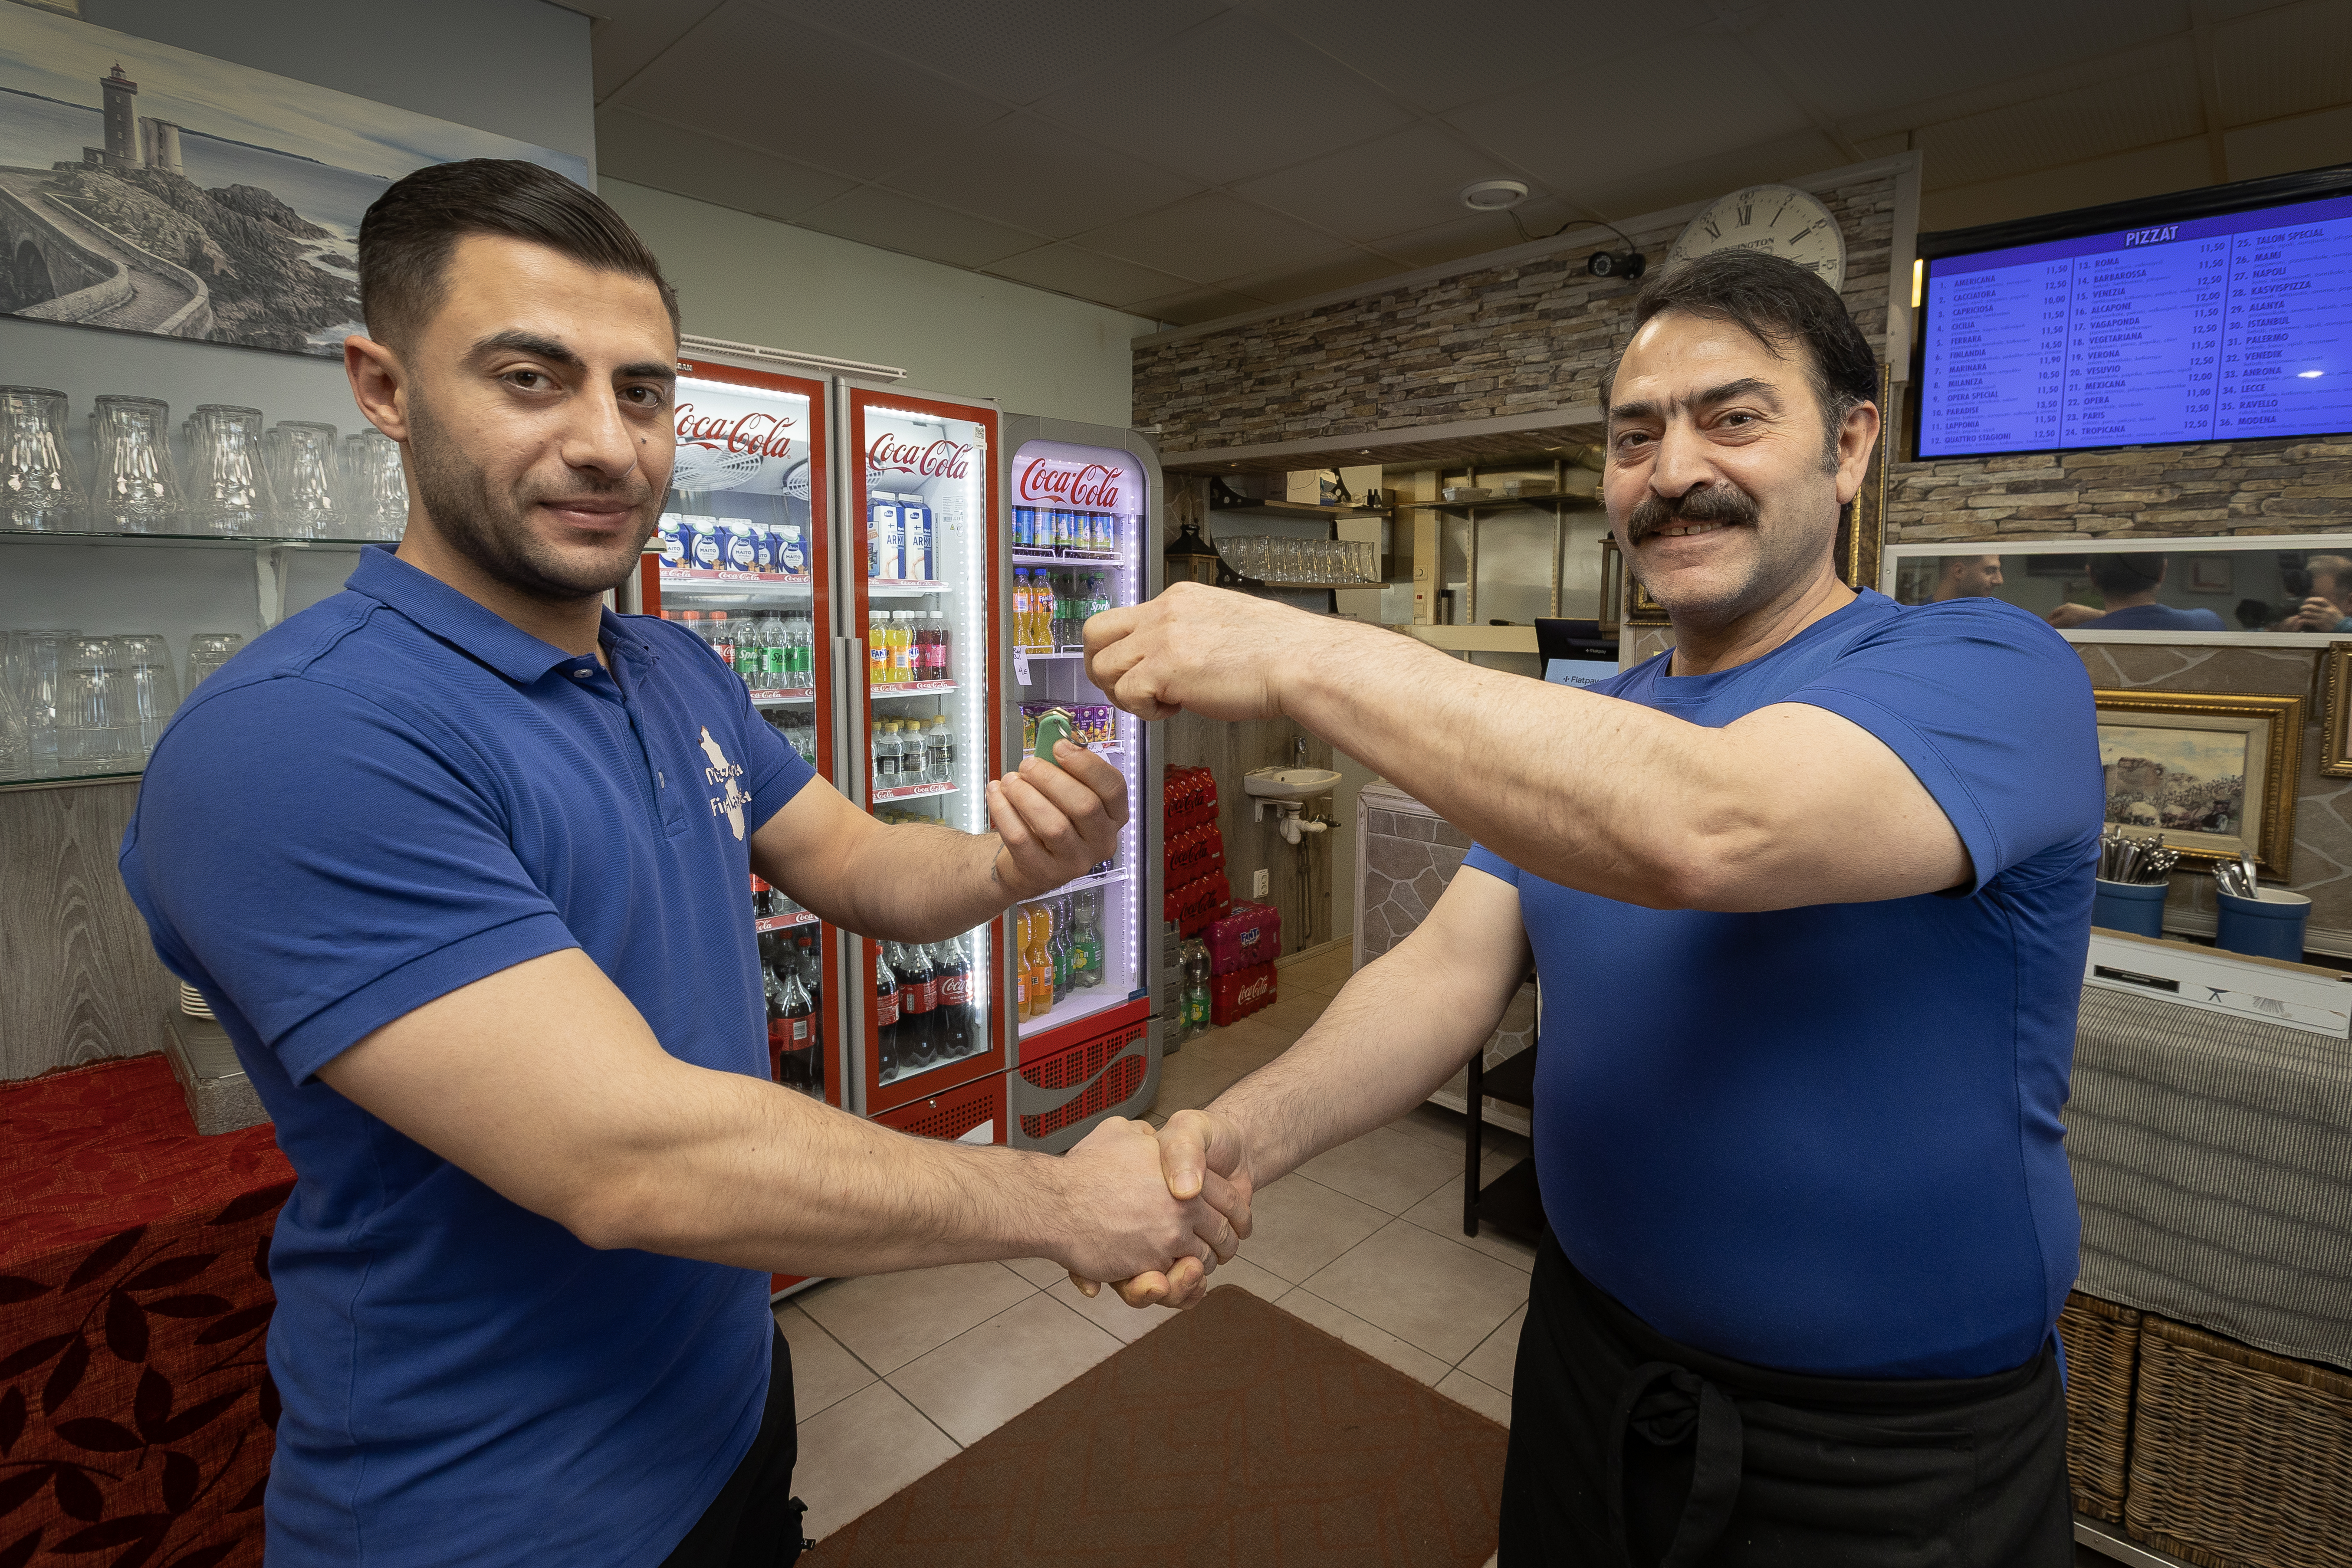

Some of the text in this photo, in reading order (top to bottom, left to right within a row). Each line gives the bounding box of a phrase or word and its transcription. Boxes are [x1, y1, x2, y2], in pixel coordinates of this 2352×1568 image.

[2126, 226, 2178, 246] PIZZAT
[2256, 233, 2286, 245] TALON
[2287, 228, 2324, 240] SPECIAL
[2095, 258, 2119, 268] ROMA
[2201, 242, 2225, 253] 11,50
[1955, 275, 1995, 287] AMERICANA
[2047, 265, 2068, 275] 11,50
[2094, 269, 2146, 283] BARBAROSSA
[2199, 259, 2223, 269] 11,50
[2253, 267, 2286, 278] NAPOLI
[1954, 290, 1996, 302] CACCIATORA
[2046, 280, 2066, 290] 12,50
[2093, 288, 2125, 298] VENEZIA
[2197, 275, 2222, 285] 12,50
[2251, 281, 2312, 295] KASVISPIZZA
[1953, 305, 1994, 316] CAPRICIOSA
[2044, 295, 2065, 304] 10,00
[2091, 302, 2132, 314] ALCAPONE
[2196, 292, 2221, 302] 12,00
[2249, 300, 2285, 312] ALANYA
[2043, 310, 2064, 320] 11,50
[2090, 317, 2140, 329] VAGAPONDA
[2194, 308, 2218, 318] 11,50
[2248, 316, 2290, 328] ISTANBUL
[1951, 335, 1982, 345] FERRARA
[2042, 325, 2063, 335] 11,50
[2089, 332, 2142, 344] VEGETARIANA
[2193, 325, 2217, 334] 12,50
[2246, 333, 2289, 344] PALERMO
[1950, 349, 1986, 359] FINLANDIA
[2041, 341, 2062, 350] 14,50
[2088, 350, 2120, 359] VERONA
[2191, 340, 2215, 351] 11,50
[2244, 350, 2283, 360] VENEDIK
[1949, 363, 1987, 373] MARINARA
[2040, 356, 2060, 365] 11,90
[2087, 365, 2121, 374] VESUVIO
[2190, 356, 2213, 366] 12,50
[1948, 378, 1983, 387] MILANEZA
[2039, 371, 2060, 379] 10,50
[2085, 380, 2126, 390] MEXICANA
[2188, 373, 2212, 382] 12,00
[1948, 394, 1969, 402] OPERA
[1972, 390, 1998, 400] SPECIAL
[2038, 386, 2058, 394] 11,50
[2084, 396, 2109, 405] OPERA
[2187, 388, 2211, 397] 11,00
[2241, 384, 2266, 393] LECCE
[1946, 407, 1979, 415] PARADISE
[2083, 412, 2105, 420] PARIS
[2186, 404, 2209, 413] 12,50
[2239, 399, 2278, 409] RAVELLO
[1945, 421, 1979, 430] LAPPONIA
[2082, 425, 2125, 434] TROPICANA
[2184, 420, 2207, 429] 12,50
[2237, 416, 2276, 425] MODENA
[1945, 435, 1976, 443] QUATTRO
[1978, 433, 2011, 442] STAGIONI
[868, 433, 973, 479] Coca-Cola
[1020, 458, 1125, 508] Coca-Cola
[887, 535, 904, 546] ARKI
[913, 536, 931, 546] ARKI
[660, 569, 692, 577] a-Cola
[718, 571, 760, 581] Coca-Cola
[1091, 601, 1110, 613] Sprit
[1571, 676, 1600, 685] Flatpay
[872, 791, 894, 799] a-Cola
[914, 785, 946, 794] Coca-Cola
[1168, 788, 1204, 817] Coca-Cola
[1170, 839, 1208, 871] Coca-Cola
[1180, 891, 1217, 922] Coca-Cola
[1238, 975, 1268, 1005] Coca-Cola
